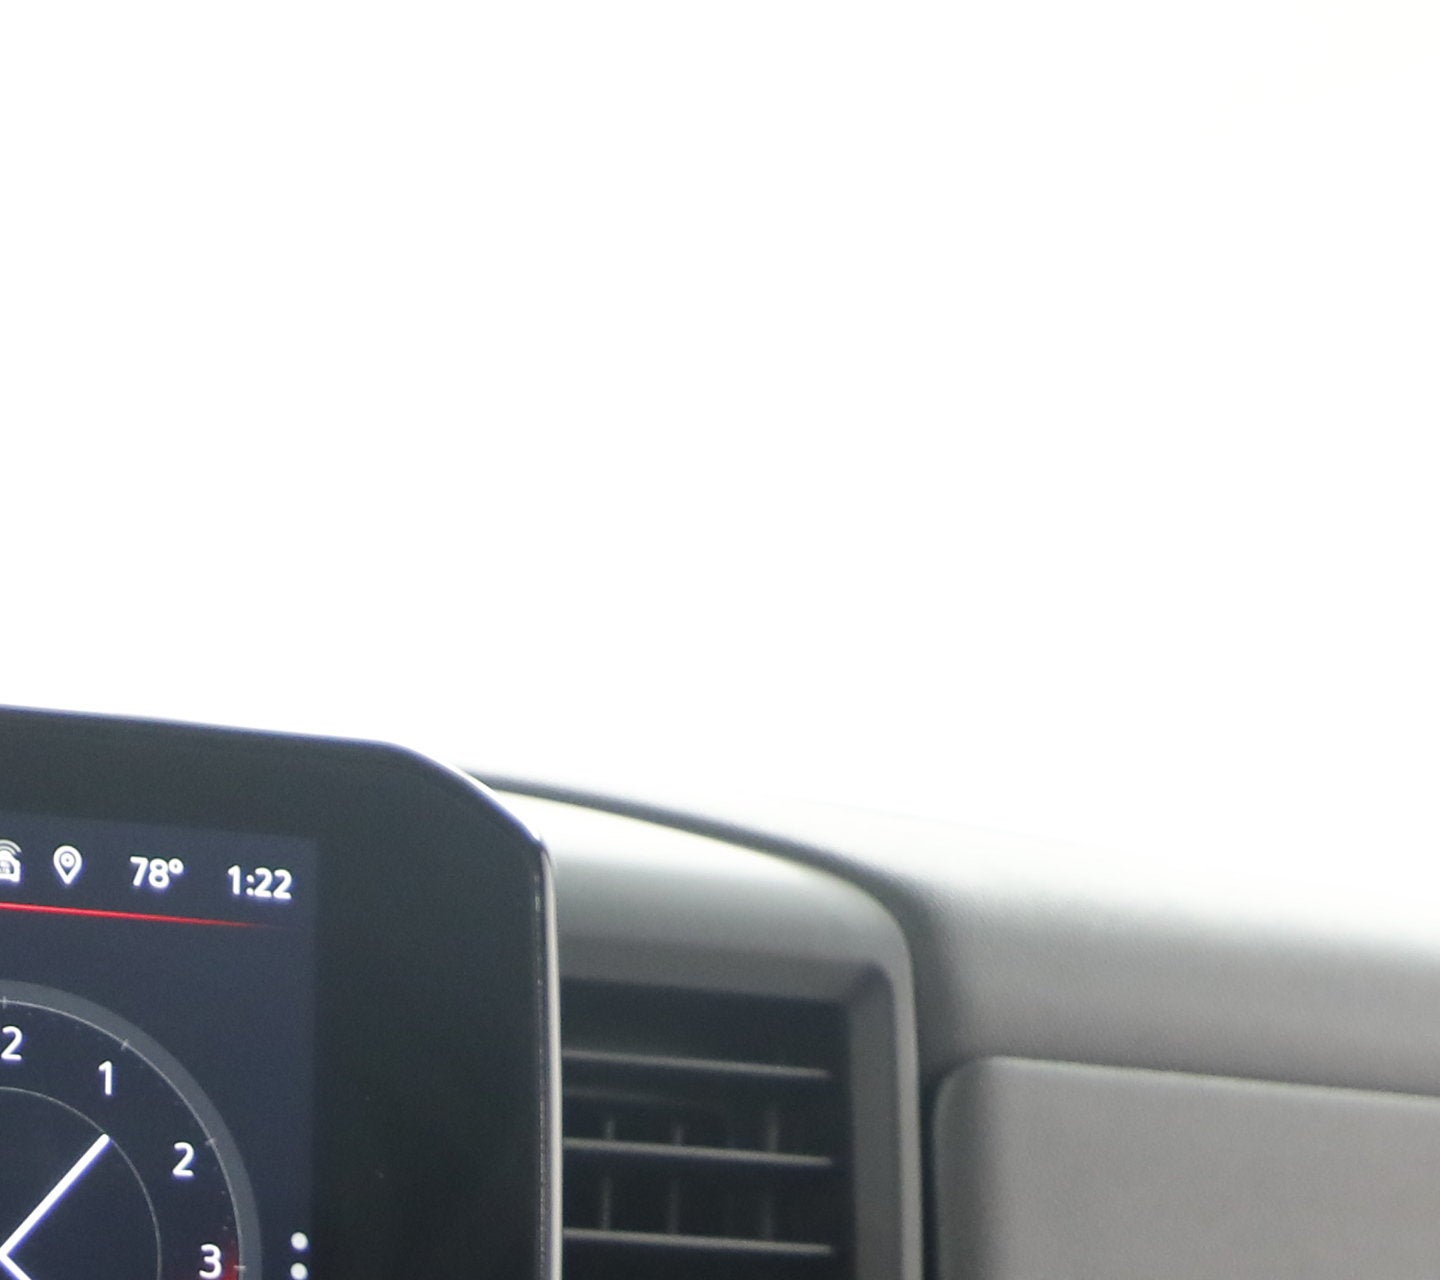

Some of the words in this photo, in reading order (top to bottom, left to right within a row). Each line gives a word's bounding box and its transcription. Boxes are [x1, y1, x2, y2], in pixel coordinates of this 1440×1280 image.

[228, 866, 292, 902] 1:22
[99, 1061, 112, 1095] 1
[173, 1142, 194, 1179] 2
[200, 1244, 221, 1279] 3
